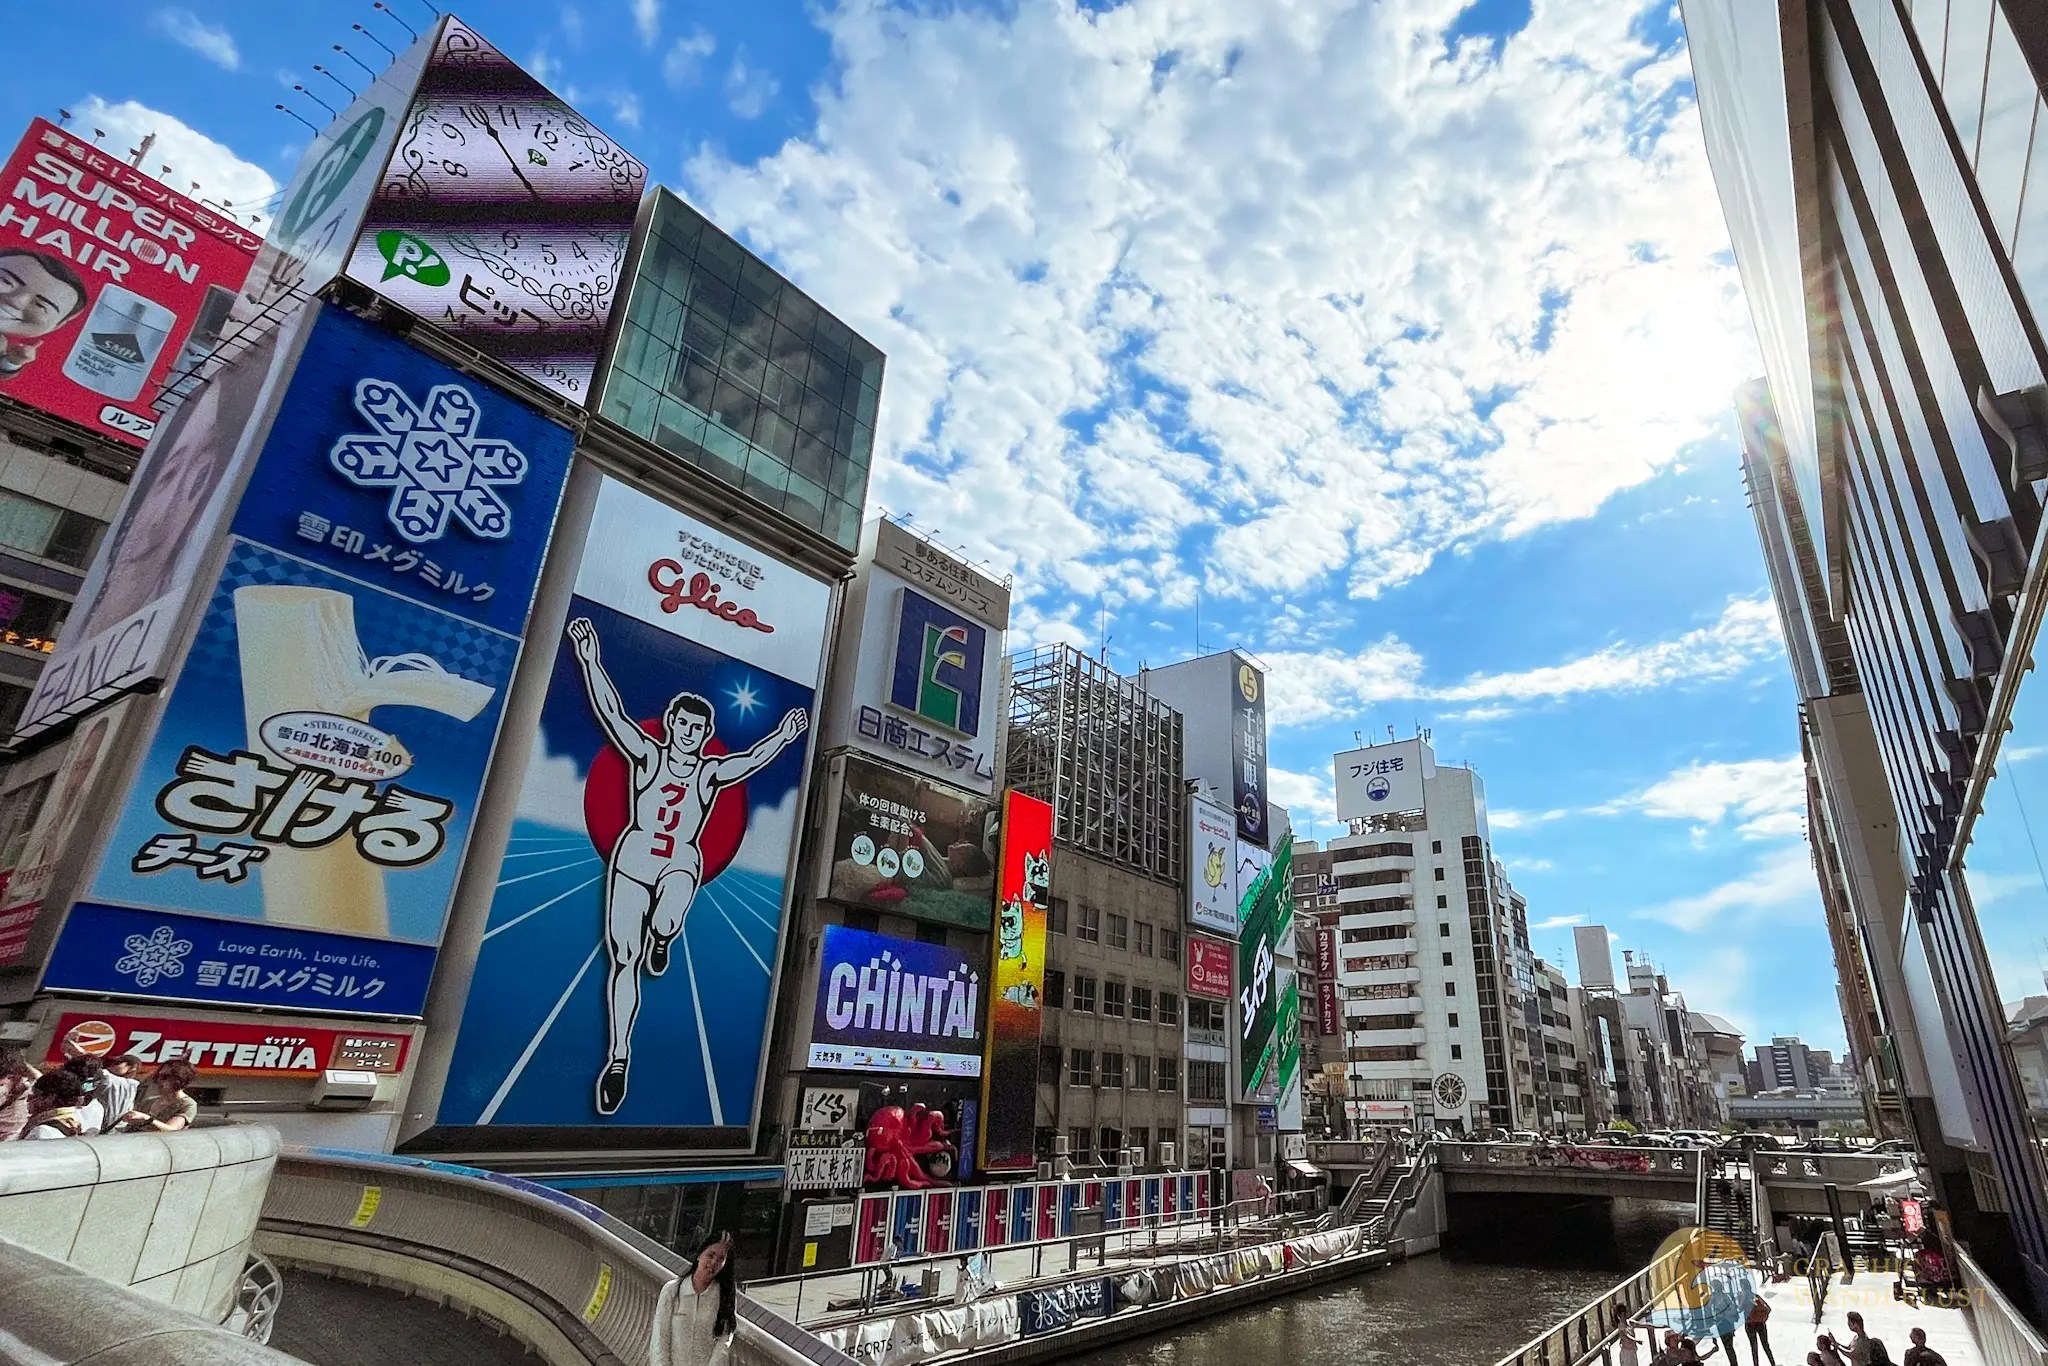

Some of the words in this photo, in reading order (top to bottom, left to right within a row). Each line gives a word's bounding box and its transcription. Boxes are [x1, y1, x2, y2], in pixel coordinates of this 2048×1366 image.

[441, 122, 466, 147] 9
[532, 122, 558, 151] 12
[442, 159, 468, 178] 8
[27, 152, 198, 252] SUPER
[0, 203, 131, 283] HAIR
[12, 176, 201, 285] MILLION
[541, 244, 558, 265] 5
[571, 241, 588, 261] 4
[104, 339, 137, 359] SMH
[296, 510, 496, 602] 雪印メグミルク
[647, 558, 775, 634] Glico
[309, 719, 344, 732] STRING
[346, 725, 379, 745] CHEESE
[857, 704, 994, 781] 日商エステム
[1350, 757, 1404, 778] フジ住宅
[159, 748, 450, 865] さける
[650, 781, 690, 860] グリコ
[858, 791, 927, 824] 体の回復助ける
[868, 812, 914, 838] 生薬配合。
[135, 836, 266, 881] チーズ
[218, 940, 256, 955] Love
[259, 944, 308, 961] Earth.
[313, 950, 347, 966] Love
[350, 953, 381, 970] Life.
[1319, 931, 1330, 972] カラオケ
[195, 959, 387, 1000] 雪印メグミルク
[1322, 984, 1333, 1034] ネットカフェ
[125, 1030, 318, 1071] ZETTERIA
[264, 1036, 307, 1047] ゼッテリア
[355, 1059, 392, 1068] コーヒー
[813, 1092, 847, 1124] くくる
